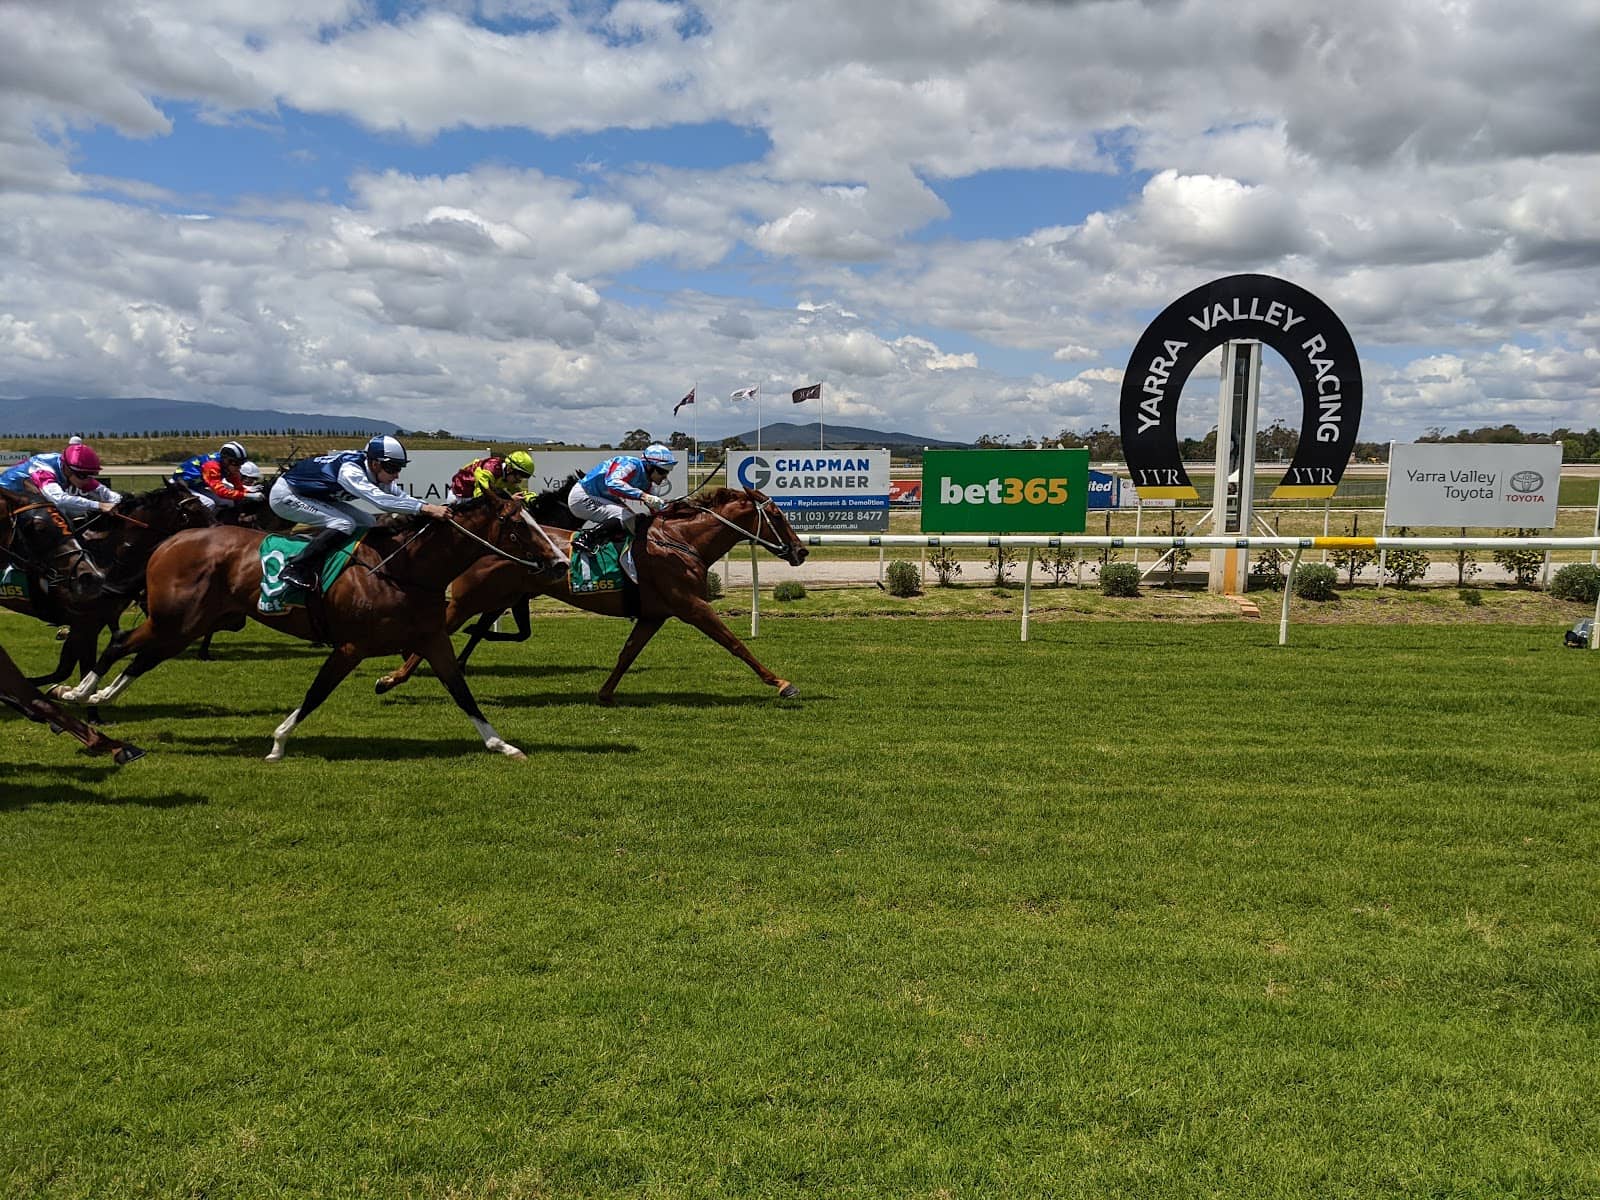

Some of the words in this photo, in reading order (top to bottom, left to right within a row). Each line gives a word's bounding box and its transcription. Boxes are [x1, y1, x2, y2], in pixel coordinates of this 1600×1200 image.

[1137, 339, 1189, 434] YARRA
[1188, 297, 1306, 332] VALLEY
[1302, 333, 1342, 443] RACING
[775, 458, 870, 472] CHAPMAN
[775, 475, 869, 489] GARDNER
[1139, 469, 1181, 485] YVR
[1293, 467, 1336, 484] YVR
[1407, 469, 1447, 482] Yarra
[1449, 470, 1496, 486] Valley
[940, 476, 1068, 505] bet365
[1088, 480, 1113, 492] ited
[1443, 485, 1494, 501] Toyota
[1505, 494, 1545, 503] TOYOTA
[805, 511, 825, 523] (03)
[828, 511, 854, 521] 9728
[857, 511, 883, 521] 8477
